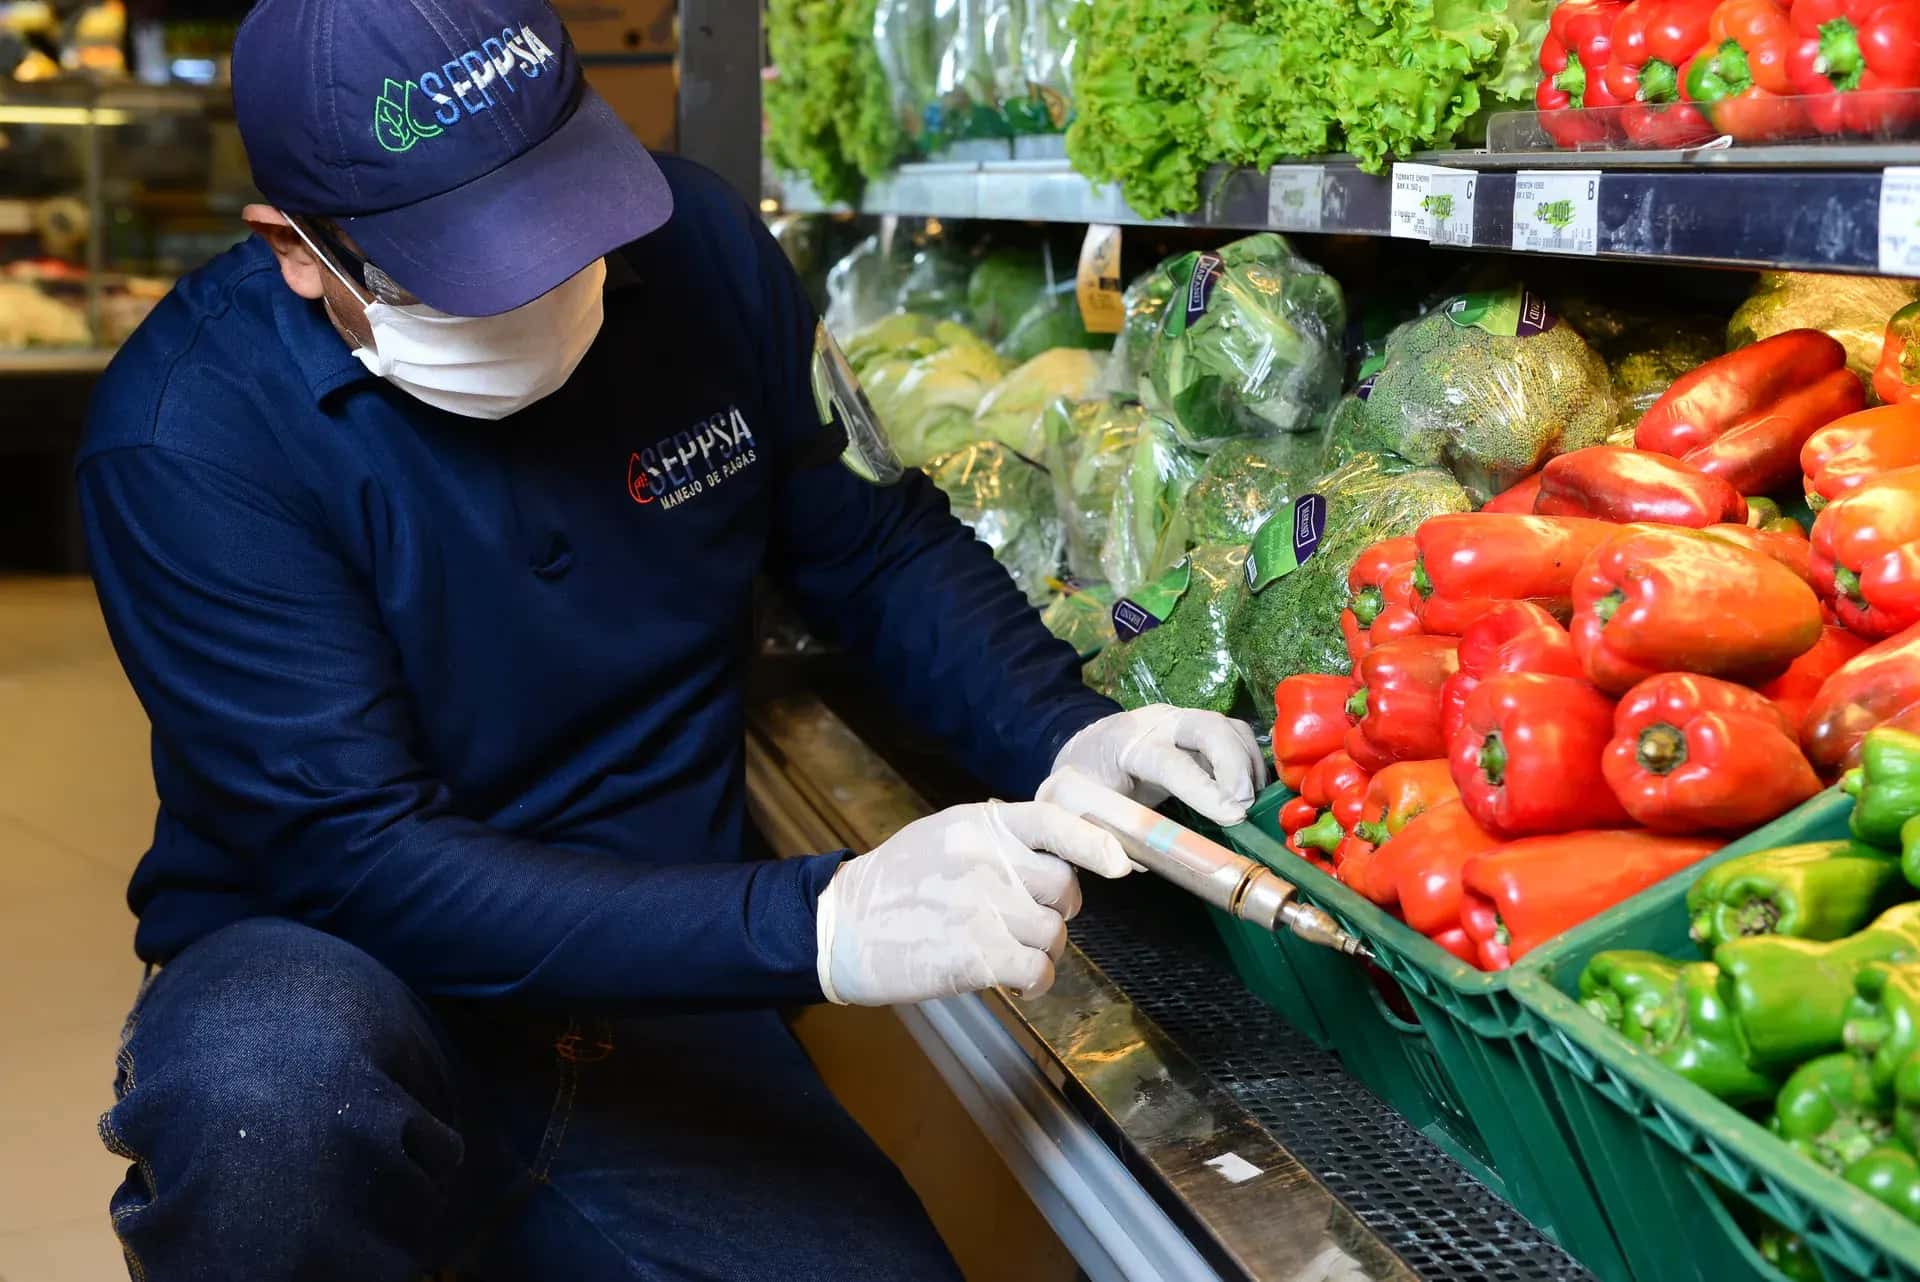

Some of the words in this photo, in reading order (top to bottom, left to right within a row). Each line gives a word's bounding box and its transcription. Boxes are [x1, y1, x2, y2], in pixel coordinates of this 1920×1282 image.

[420, 22, 558, 126] SEPPSA
[1466, 180, 1473, 200] C
[1587, 180, 1595, 200] B
[641, 404, 756, 496] SEPPSA
[660, 480, 703, 510] MANEJO
[706, 471, 722, 487] DE
[722, 449, 757, 478] PLAGAS
